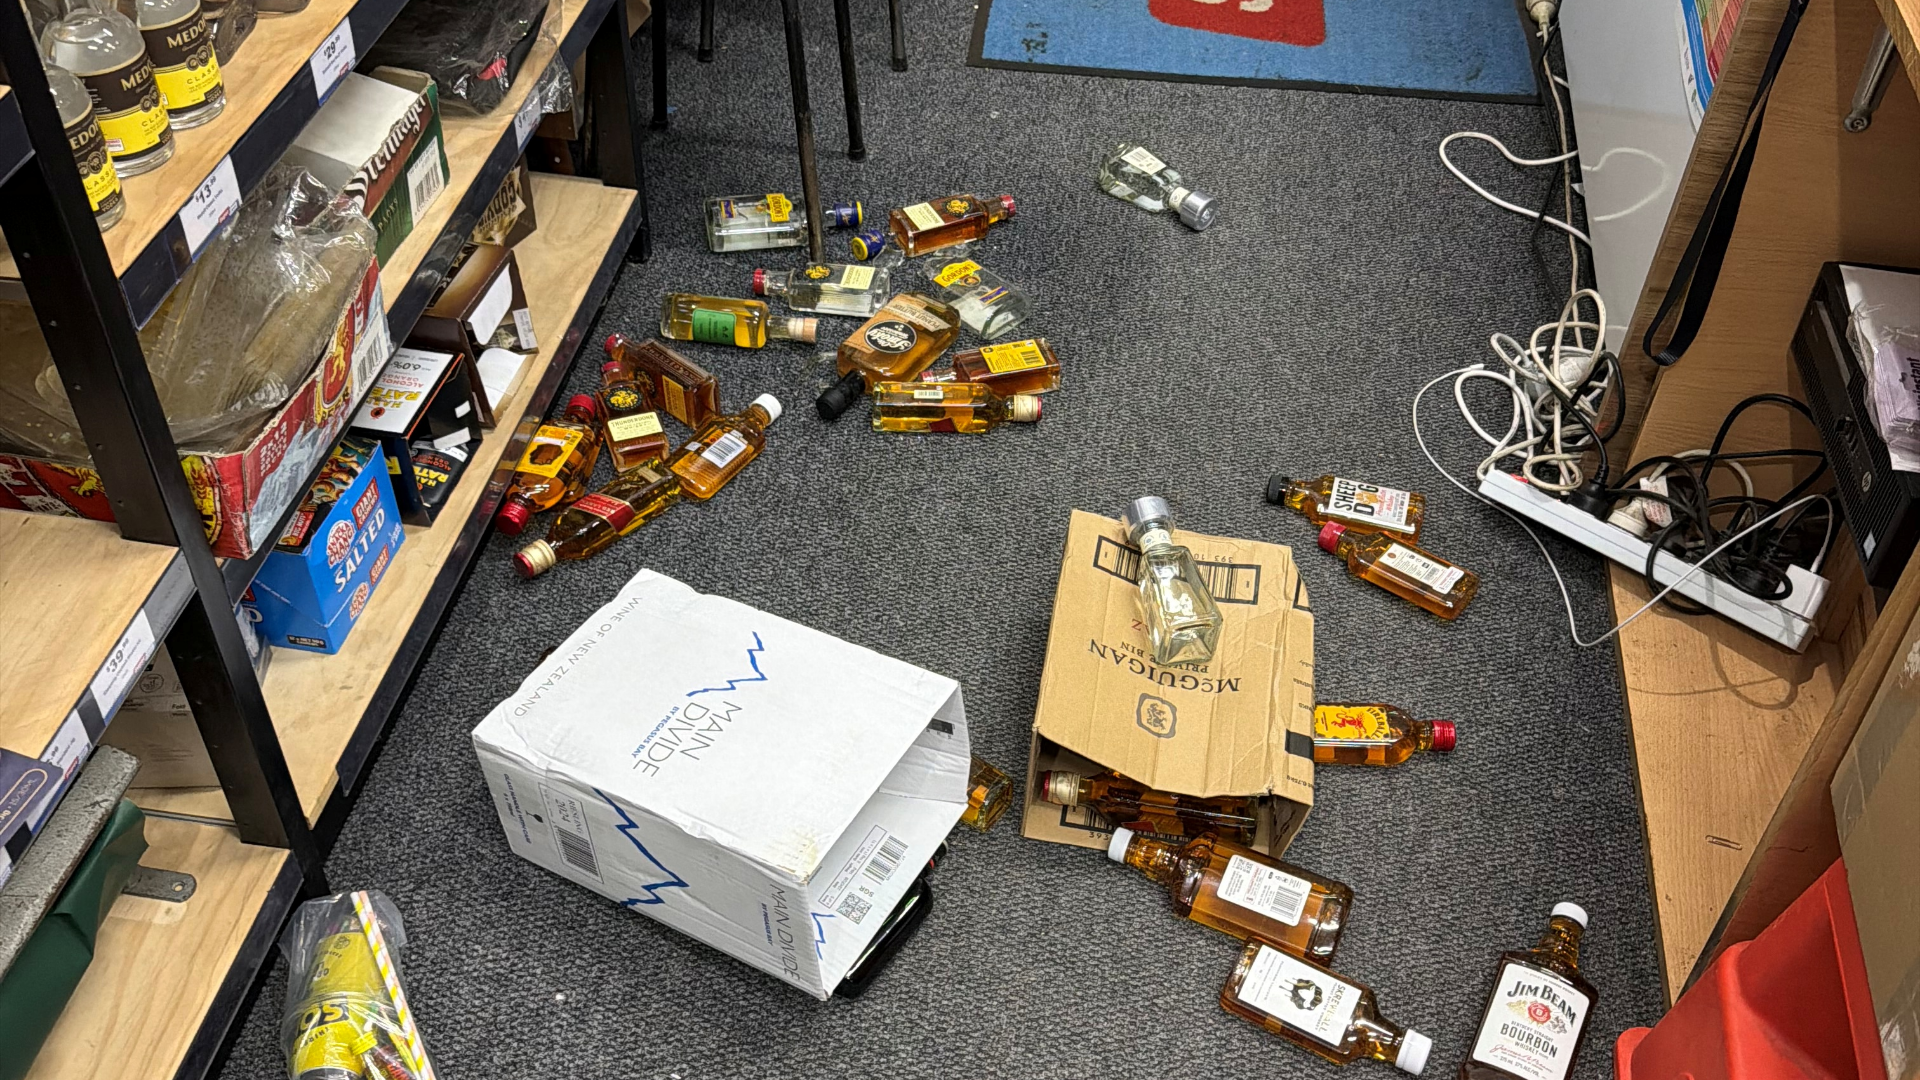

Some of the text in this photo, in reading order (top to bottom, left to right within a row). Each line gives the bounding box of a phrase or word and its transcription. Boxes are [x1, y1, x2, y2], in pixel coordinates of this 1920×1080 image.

[196, 175, 216, 204] $13.99
[771, 194, 785, 218] GORDON'S
[893, 304, 941, 329] PEANUT BUTTER
[381, 378, 424, 388] ALCOHOL
[356, 482, 376, 518] GIANT
[1334, 480, 1358, 511] SHEEP
[334, 507, 386, 593] SALTED
[514, 596, 643, 717] WINE OF NEW ZEALAND
[1120, 641, 1145, 656] BIN
[631, 706, 680, 758] BY PEGASUS BAY
[680, 700, 743, 760] MAIN
[1367, 707, 1385, 740] FIREBALL
[632, 702, 710, 778] DIVIDE
[559, 800, 572, 823] 2024
[1088, 831, 1109, 840] 393
[859, 886, 874, 898] SGR
[770, 884, 800, 982] MAIN DIVIDE
[1507, 980, 1576, 1028] JIM BEAM
[1500, 1023, 1558, 1058] BOURBON
[1511, 1020, 1554, 1042] KENTUCKY STRAIGHT
[1514, 1041, 1540, 1056] WHISKEY
